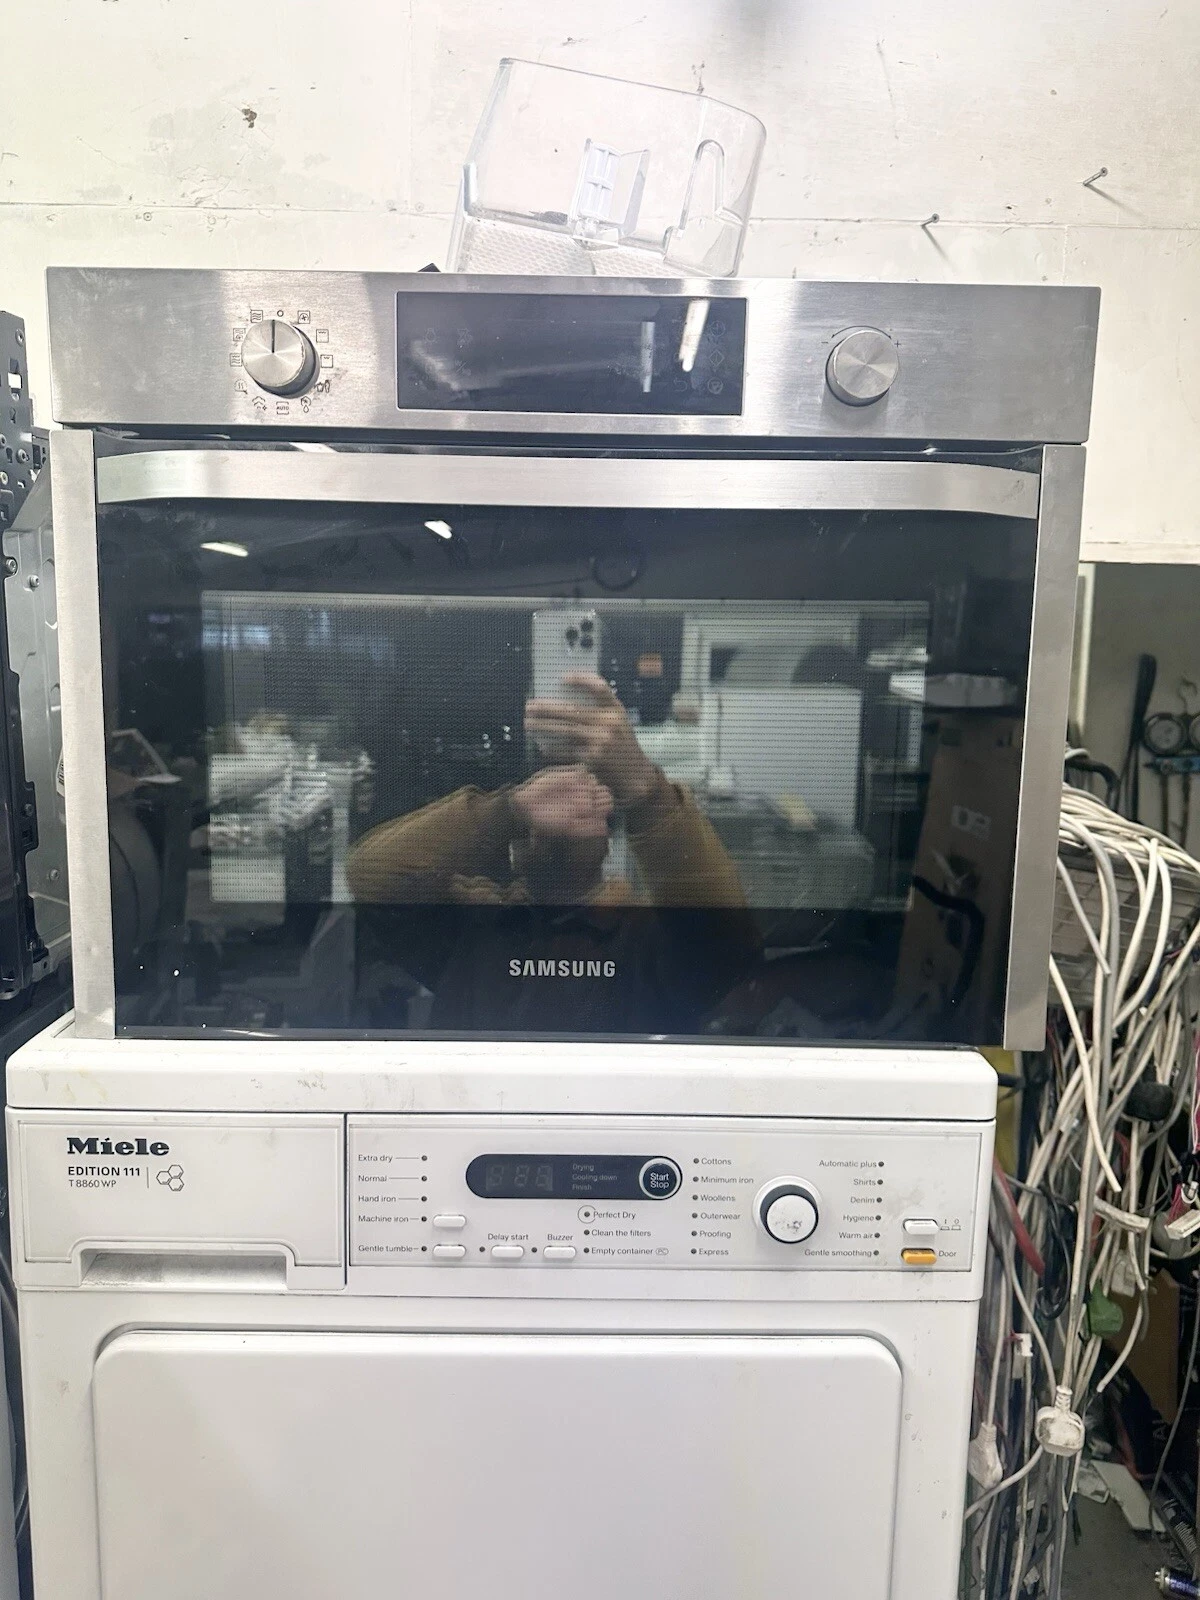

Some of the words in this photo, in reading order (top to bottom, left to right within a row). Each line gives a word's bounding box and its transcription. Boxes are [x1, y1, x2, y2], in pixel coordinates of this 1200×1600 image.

[509, 958, 616, 977] SAMSUNG
[67, 1137, 170, 1155] Miele
[358, 1154, 378, 1162] Extra
[379, 1154, 393, 1164] dry
[701, 1157, 732, 1166] Cottons
[572, 1163, 595, 1172] Drying
[819, 1159, 859, 1168] Automatic
[860, 1159, 877, 1170] plus
[68, 1166, 120, 1176] EDITION
[123, 1167, 140, 1176] 111
[358, 1174, 388, 1182] Normal
[572, 1173, 598, 1183] Cooling
[599, 1173, 618, 1181] down
[650, 1172, 669, 1181] Start
[701, 1175, 736, 1184] Minimum
[738, 1175, 755, 1184] iron
[68, 1179, 75, 1188] T
[76, 1179, 100, 1188] 8860
[101, 1179, 117, 1188] WP
[572, 1183, 592, 1191] Finish
[650, 1181, 670, 1190] Stop
[853, 1178, 876, 1187] Shirts
[358, 1195, 380, 1203] Hand
[380, 1195, 397, 1203] iron
[701, 1194, 736, 1203] Woollens
[850, 1196, 876, 1204] Denim
[358, 1214, 392, 1223] Machine
[393, 1214, 409, 1223] iron
[594, 1211, 620, 1220] Perfect
[622, 1211, 637, 1221] Dry
[701, 1212, 741, 1221] Outerwear
[843, 1214, 875, 1224] Hygiene
[547, 1233, 574, 1241] Buzzer
[591, 1228, 614, 1237] Clean
[615, 1228, 628, 1237] the
[629, 1228, 652, 1237] filters
[699, 1230, 732, 1240] Proofing
[839, 1231, 863, 1239] Warm
[864, 1231, 874, 1239] air
[487, 1233, 509, 1242] Delay
[511, 1233, 529, 1241] start
[358, 1244, 385, 1253] Gentle
[386, 1244, 413, 1253] tumble
[591, 1246, 616, 1256] Empty
[617, 1246, 653, 1255] container
[699, 1247, 730, 1257] Express
[804, 1247, 831, 1257] Gentle
[832, 1249, 872, 1258] smoothing
[938, 1249, 957, 1258] Door
